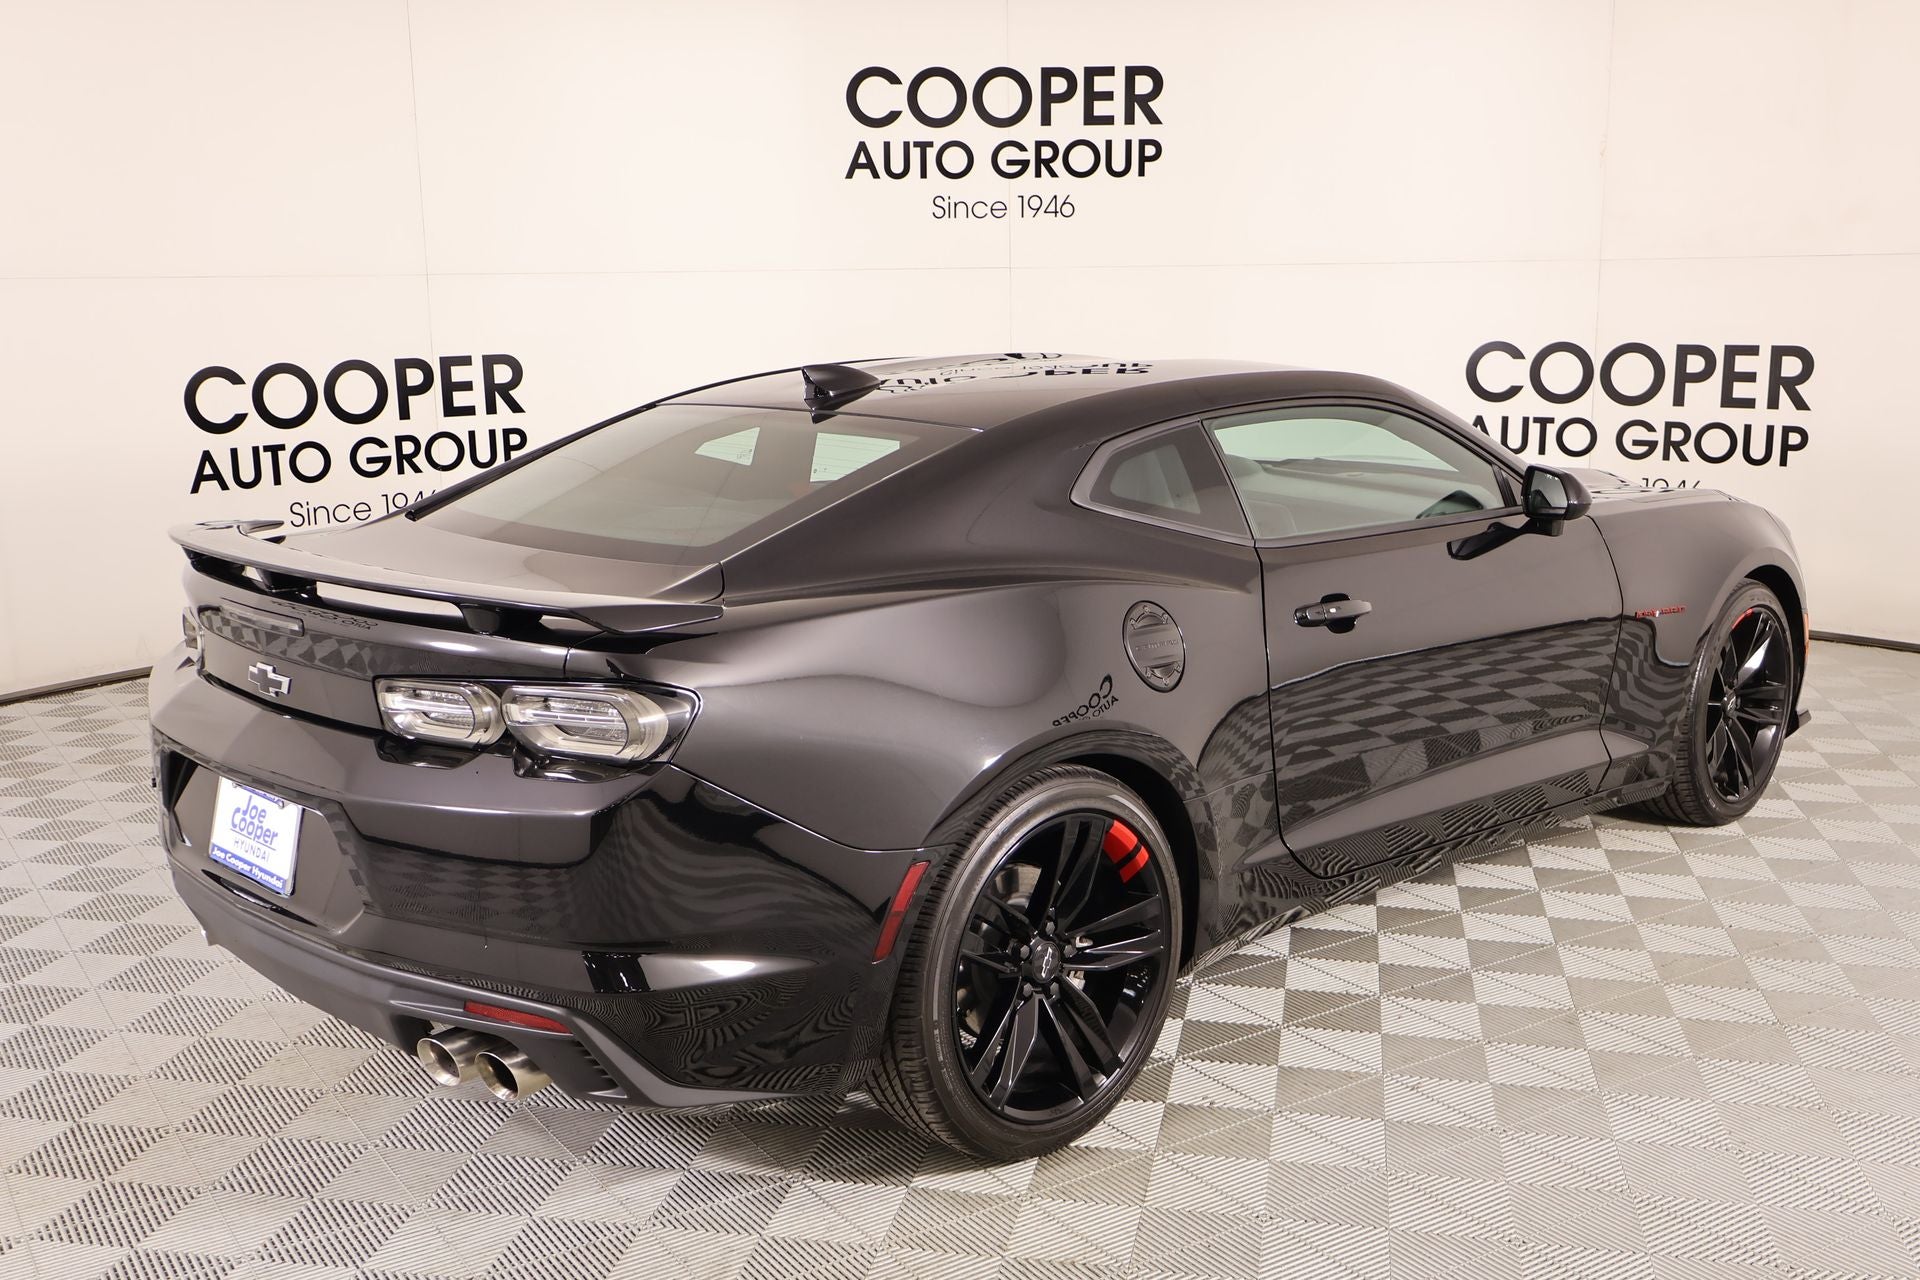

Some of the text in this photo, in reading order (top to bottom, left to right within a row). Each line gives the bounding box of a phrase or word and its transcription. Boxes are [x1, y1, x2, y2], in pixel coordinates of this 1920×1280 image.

[845, 65, 1164, 129] COOPER
[845, 138, 1163, 180] AUTO GROUP
[932, 194, 1076, 219] Since 1946
[184, 353, 527, 435] COOPER
[1465, 340, 1815, 412] COOPER
[189, 427, 529, 495] AUTO GROUP
[1614, 418, 1810, 468] GROUP
[289, 499, 372, 528] Since
[231, 806, 279, 846] Cooper
[241, 794, 267, 824] Joe
[212, 846, 284, 889] Joe Cooper Hyundai
[233, 837, 271, 863] HYUNDAI
